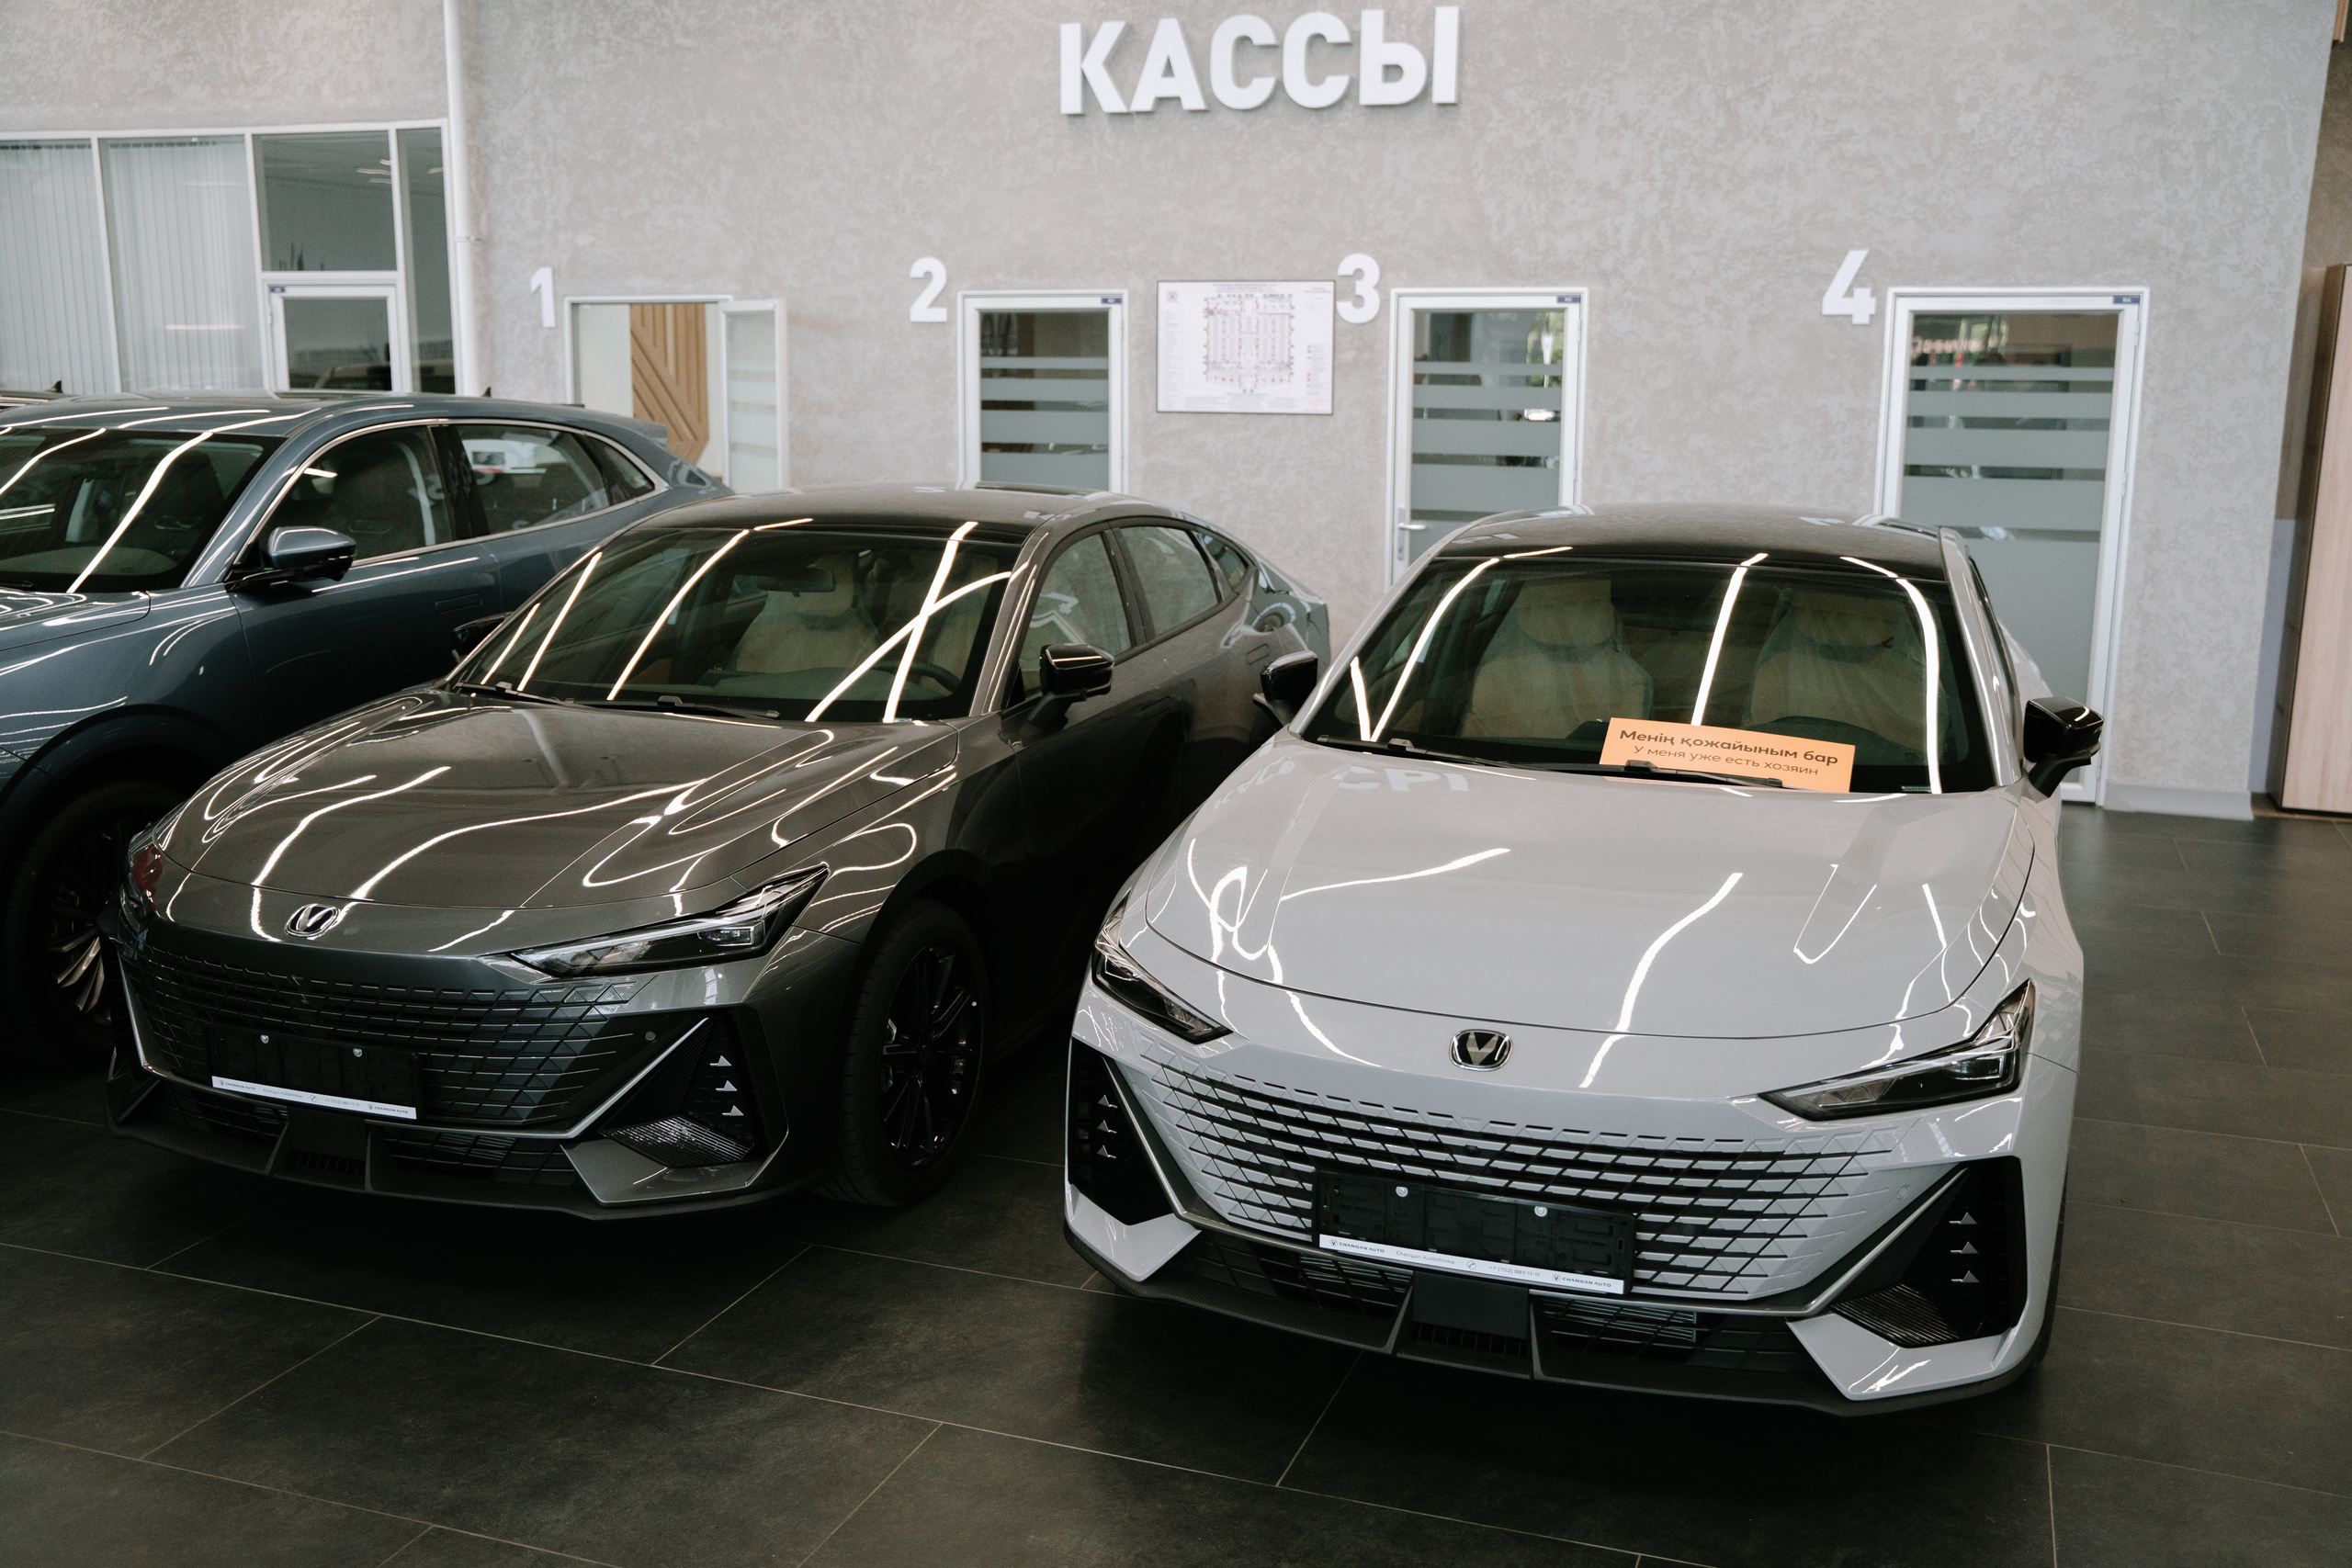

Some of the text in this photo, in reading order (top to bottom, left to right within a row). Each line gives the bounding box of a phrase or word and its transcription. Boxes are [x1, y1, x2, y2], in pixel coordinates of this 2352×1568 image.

[1059, 6, 1459, 115] КАССЫ
[529, 266, 555, 329] 1
[909, 256, 948, 323] 2
[1336, 253, 1381, 325] 3
[1821, 249, 1876, 325] 4
[1619, 729, 1838, 766] Менің қожайыным бар
[1647, 749, 1686, 759] меня
[1689, 752, 1722, 762] уже
[1725, 756, 1760, 768] есть
[1764, 761, 1818, 775] хозяин
[1339, 1241, 1368, 1250] CHANGAN
[1396, 1250, 1421, 1260] Changan
[1562, 1276, 1593, 1286] CHANGAN
